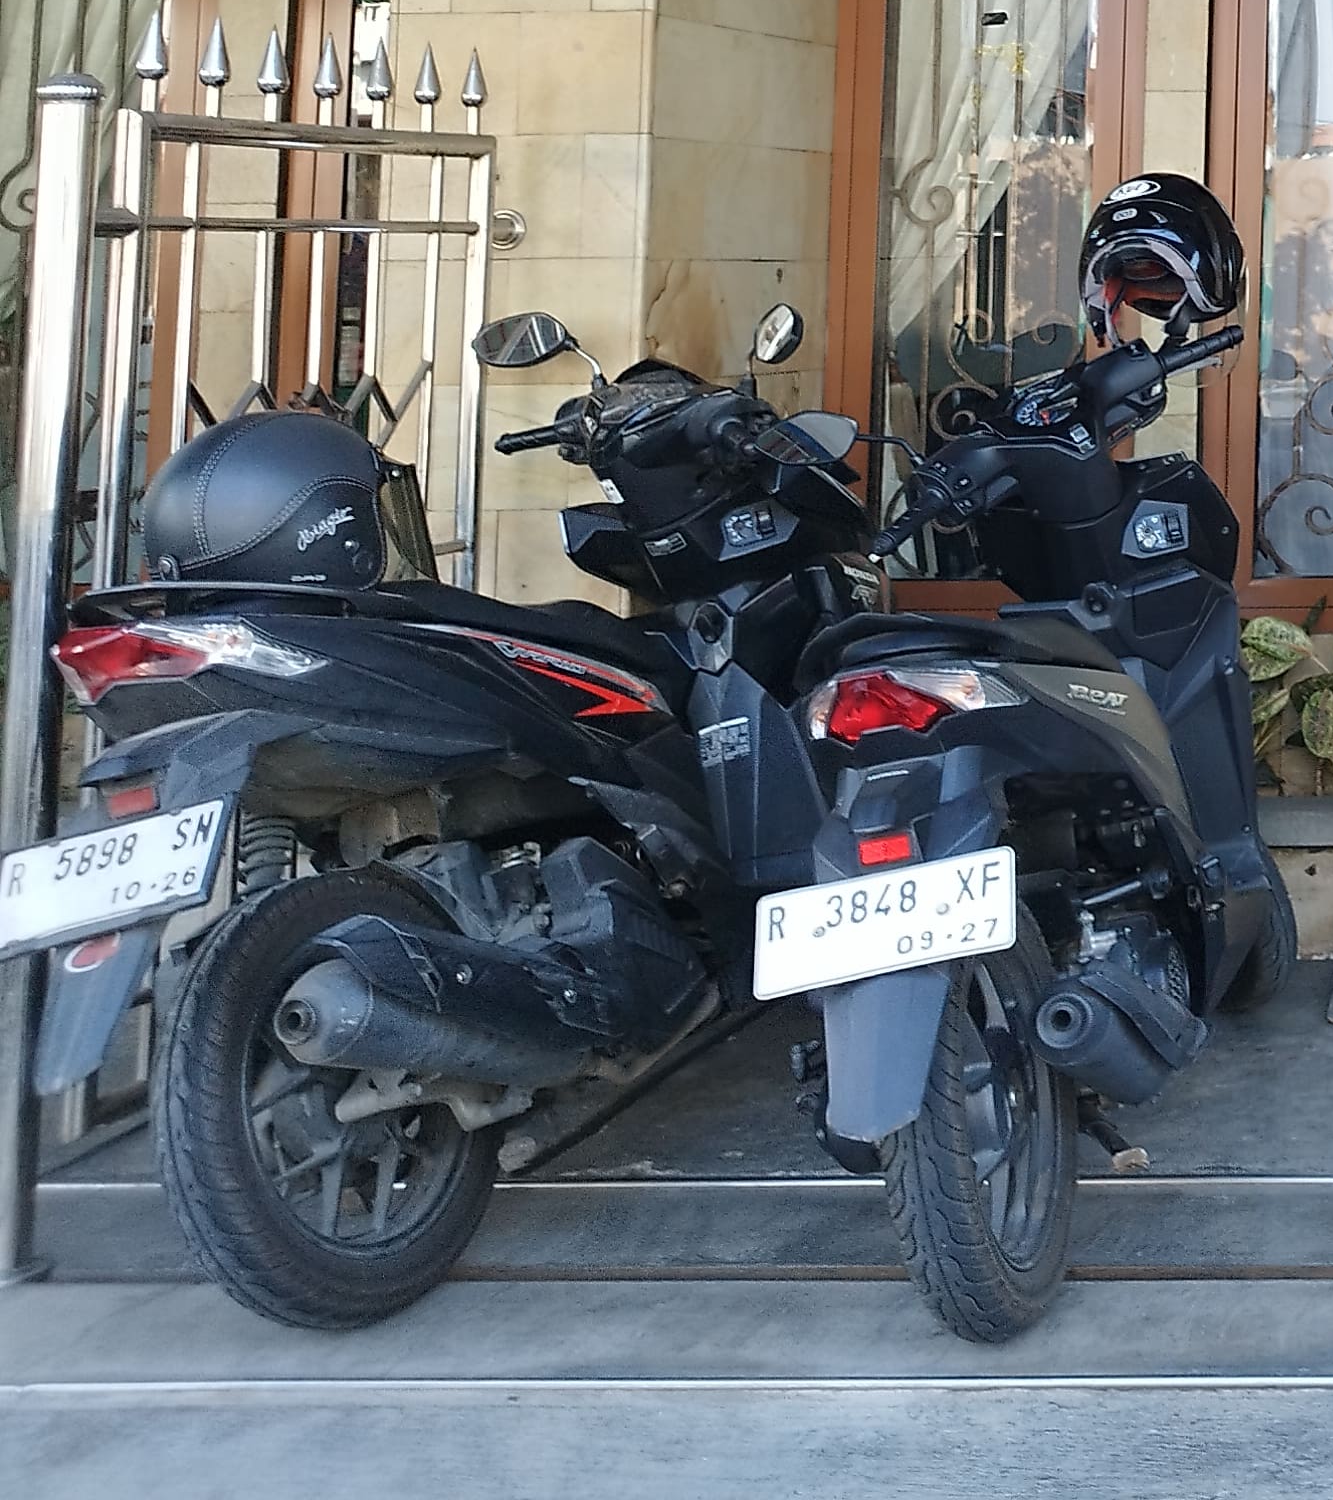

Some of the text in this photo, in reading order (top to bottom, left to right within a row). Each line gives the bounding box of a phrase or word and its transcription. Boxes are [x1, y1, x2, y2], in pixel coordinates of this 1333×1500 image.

[8, 863, 26, 898] R
[54, 832, 139, 881] 5898
[768, 861, 1001, 942] R 3848 XF
